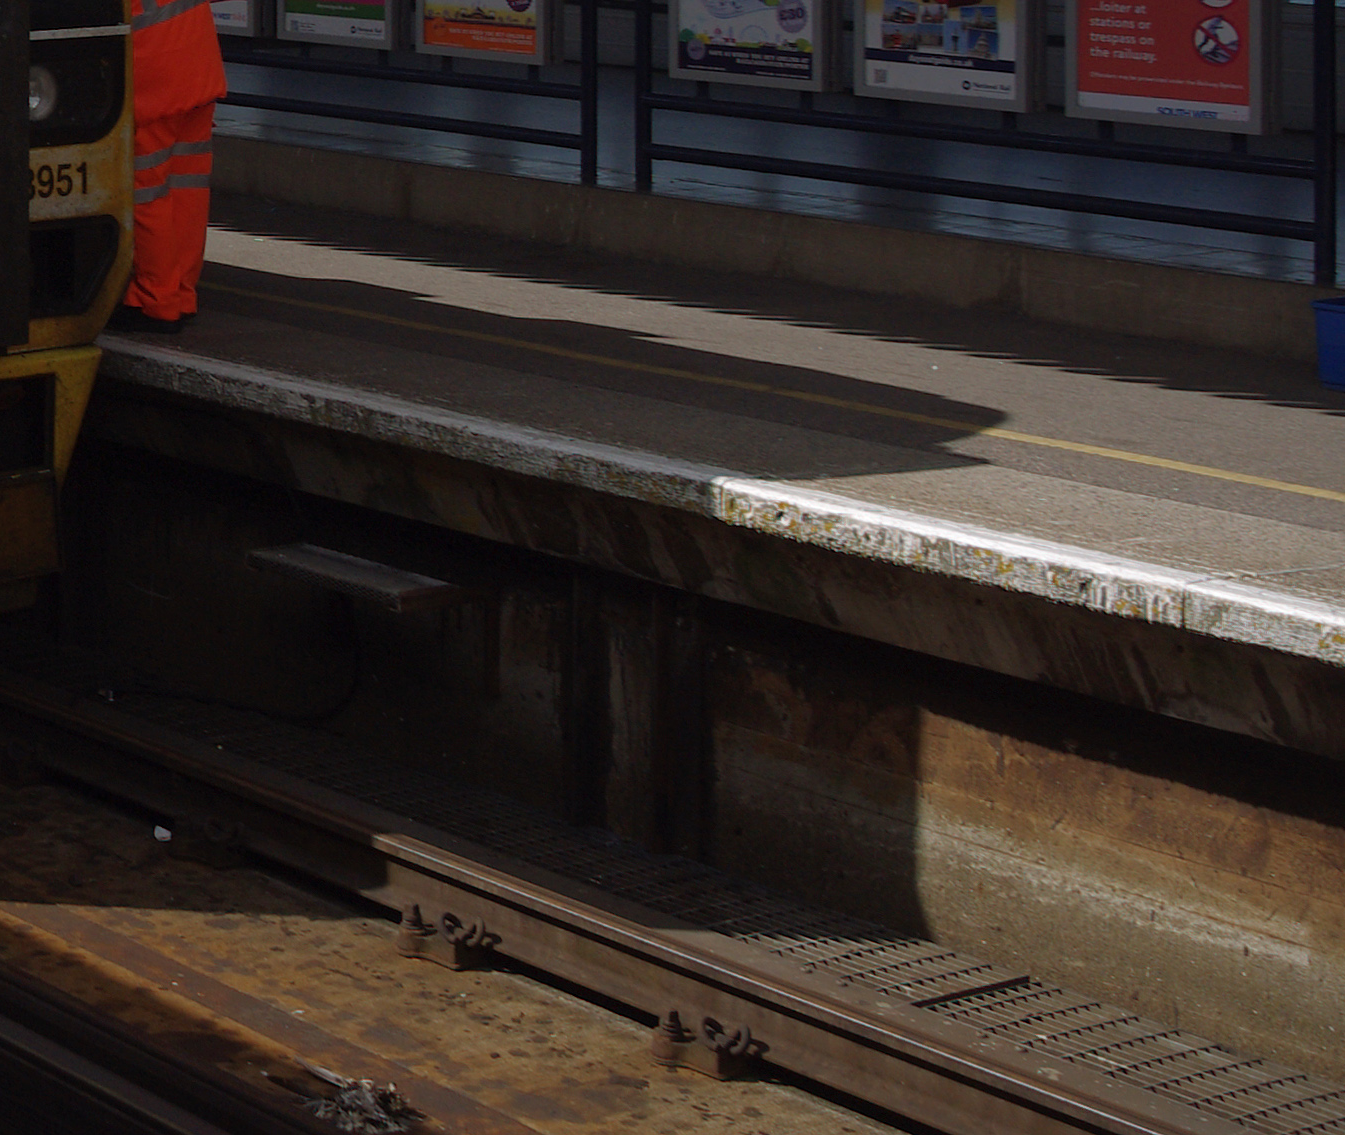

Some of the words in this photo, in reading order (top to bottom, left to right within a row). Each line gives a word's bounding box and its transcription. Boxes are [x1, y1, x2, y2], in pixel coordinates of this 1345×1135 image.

[1134, 4, 1147, 14] at
[1089, 16, 1135, 29] stations
[1137, 21, 1152, 30] or
[1089, 32, 1136, 46] trespass
[1139, 36, 1155, 45] on
[1089, 46, 1110, 58] the
[1157, 106, 1190, 117] SOUTH
[1190, 109, 1218, 120] WEST
